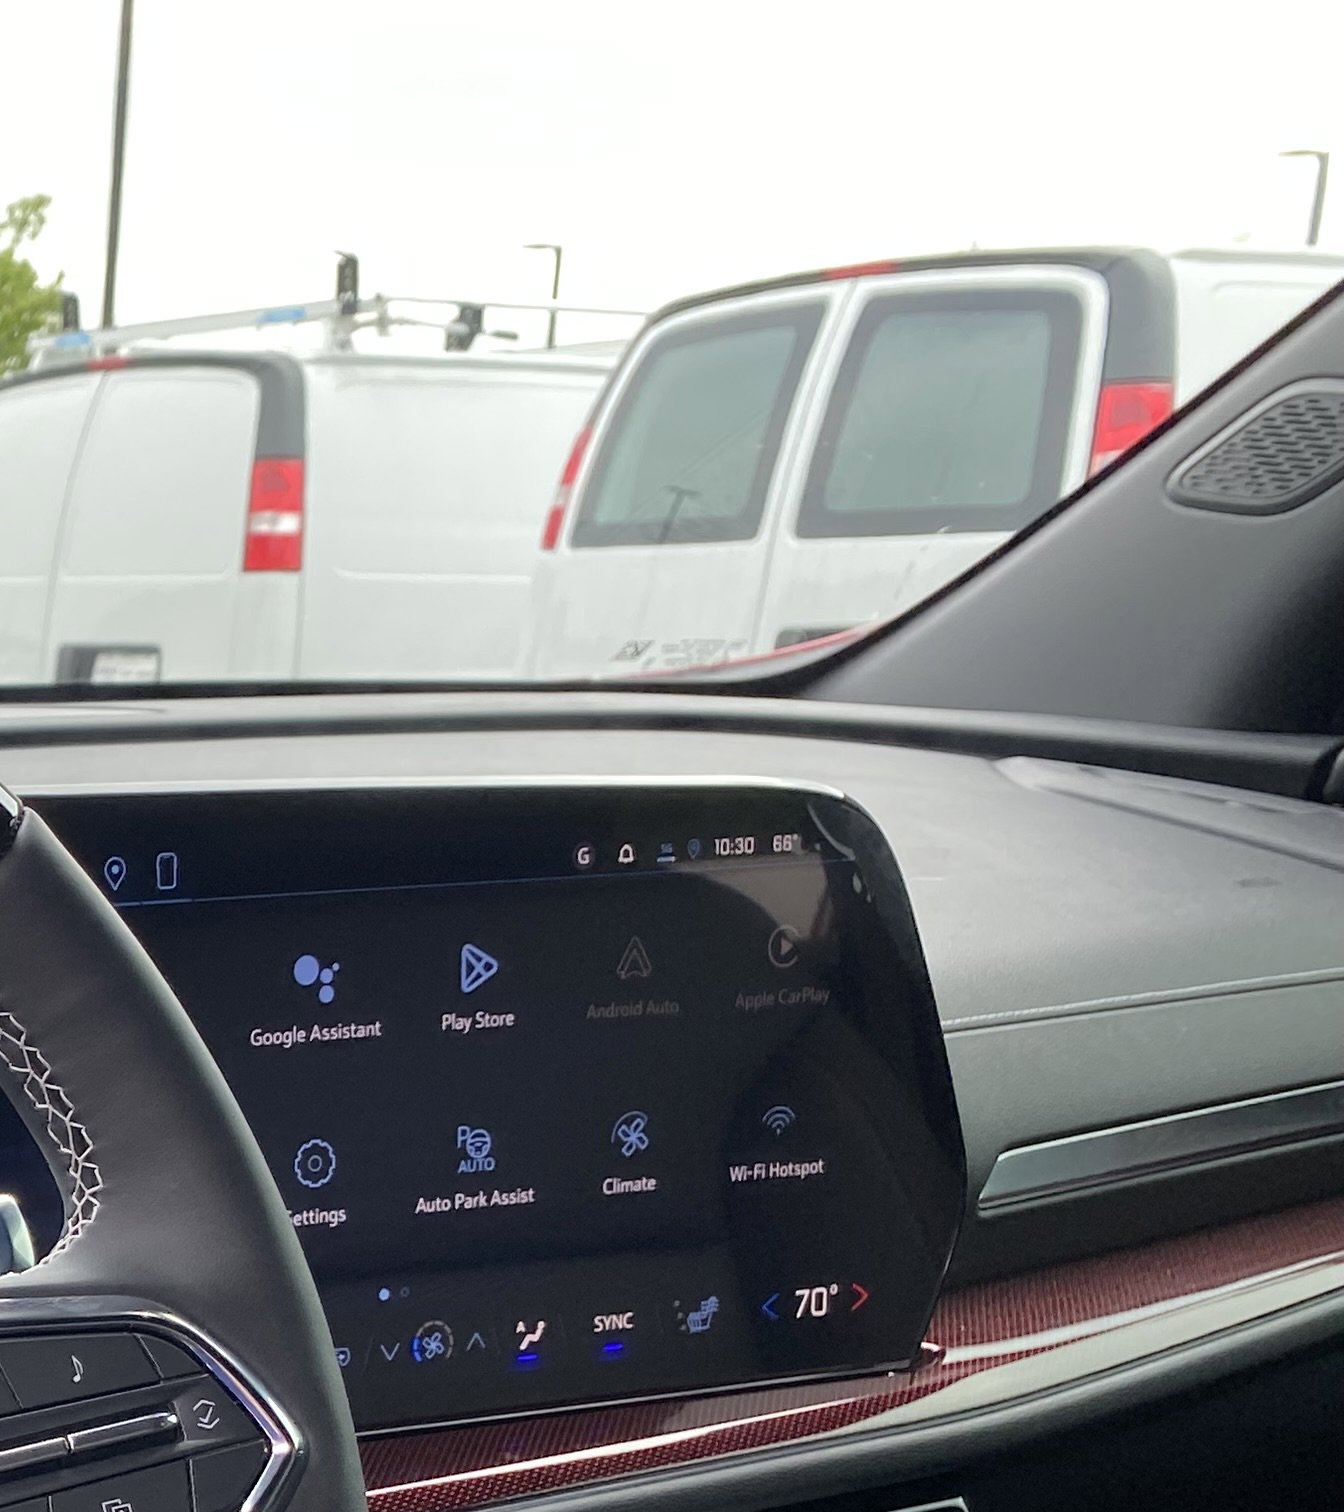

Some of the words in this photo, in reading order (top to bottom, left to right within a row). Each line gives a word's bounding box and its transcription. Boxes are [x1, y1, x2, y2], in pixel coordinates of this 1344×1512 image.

[714, 836, 755, 856] 10:30
[586, 1001, 643, 1019] Android
[646, 999, 680, 1016] Auto
[735, 991, 775, 1011] Apple
[778, 986, 831, 1006] CarPlay
[441, 1013, 473, 1034] Play
[475, 1011, 515, 1029] Store
[250, 1026, 306, 1048] Google
[309, 1021, 382, 1041] Assistant
[458, 1157, 496, 1174] AUTO
[729, 1164, 767, 1182] Wi-Fi
[769, 1158, 824, 1180] Hotspot
[602, 1175, 657, 1194] Climate
[414, 1197, 452, 1214] Auto
[455, 1191, 488, 1210] Park
[490, 1187, 536, 1206] Assist
[794, 1284, 839, 1319] 70°
[593, 1312, 635, 1333] SYNC
